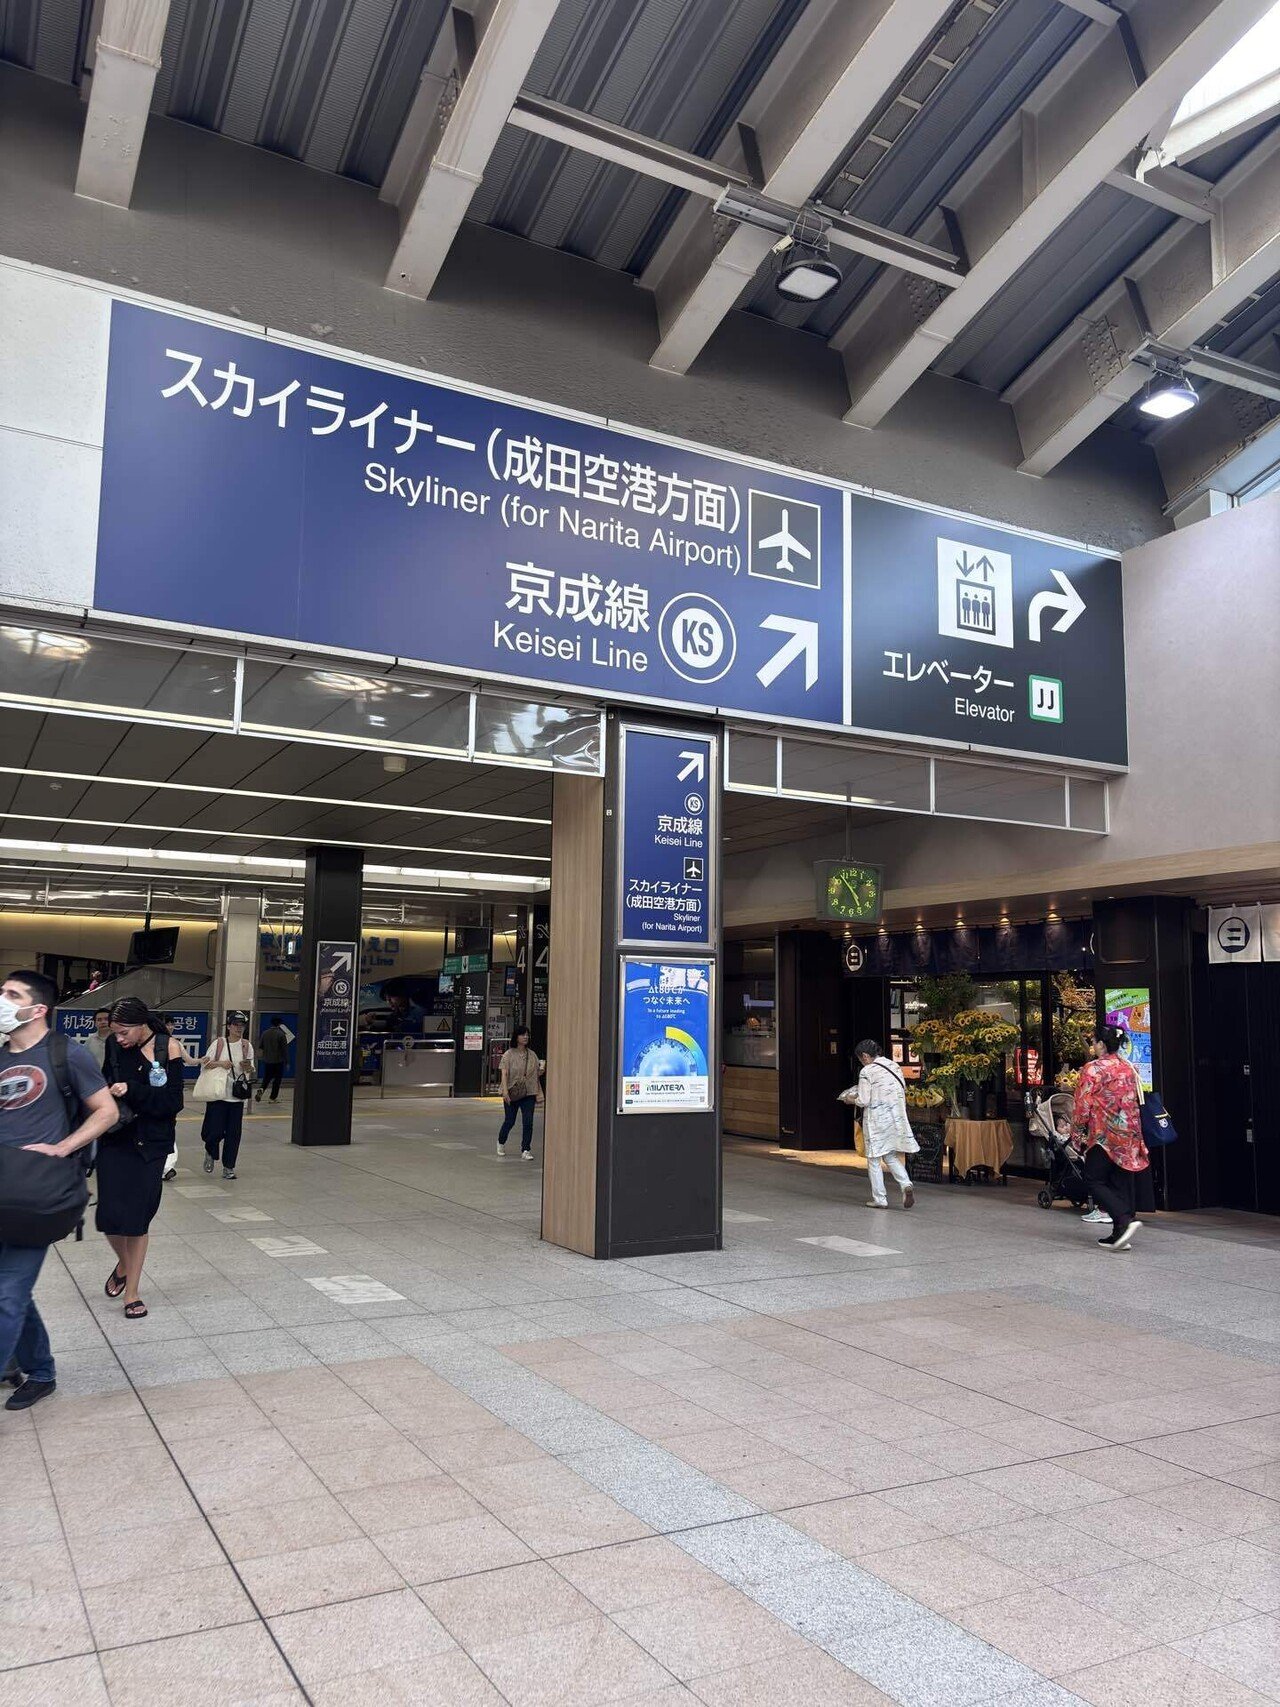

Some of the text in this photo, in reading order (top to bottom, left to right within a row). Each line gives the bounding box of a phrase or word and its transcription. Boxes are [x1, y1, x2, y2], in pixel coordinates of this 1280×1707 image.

[364, 462, 742, 575] Skyliner (for Narita Airport)
[504, 560, 650, 636] 京成線
[680, 618, 716, 656] KS
[493, 620, 649, 673] Keisei Line
[883, 650, 1015, 694] エレベーター
[955, 688, 1055, 723] Elevator JJ
[689, 799, 699, 810] KS
[657, 815, 703, 835] 京成線
[654, 835, 703, 848] Keisei Line
[629, 879, 702, 895] スカイライナー
[626, 894, 702, 913] (成田空港方面)
[674, 913, 701, 923] Skyliner
[642, 922, 702, 934] (for Narita Airport)
[517, 946, 526, 974] 4
[465, 986, 471, 995] 3
[643, 996, 691, 1005] つなぐ未来へ
[63, 1014, 95, 1030] 机场
[173, 1016, 198, 1030] 공항
